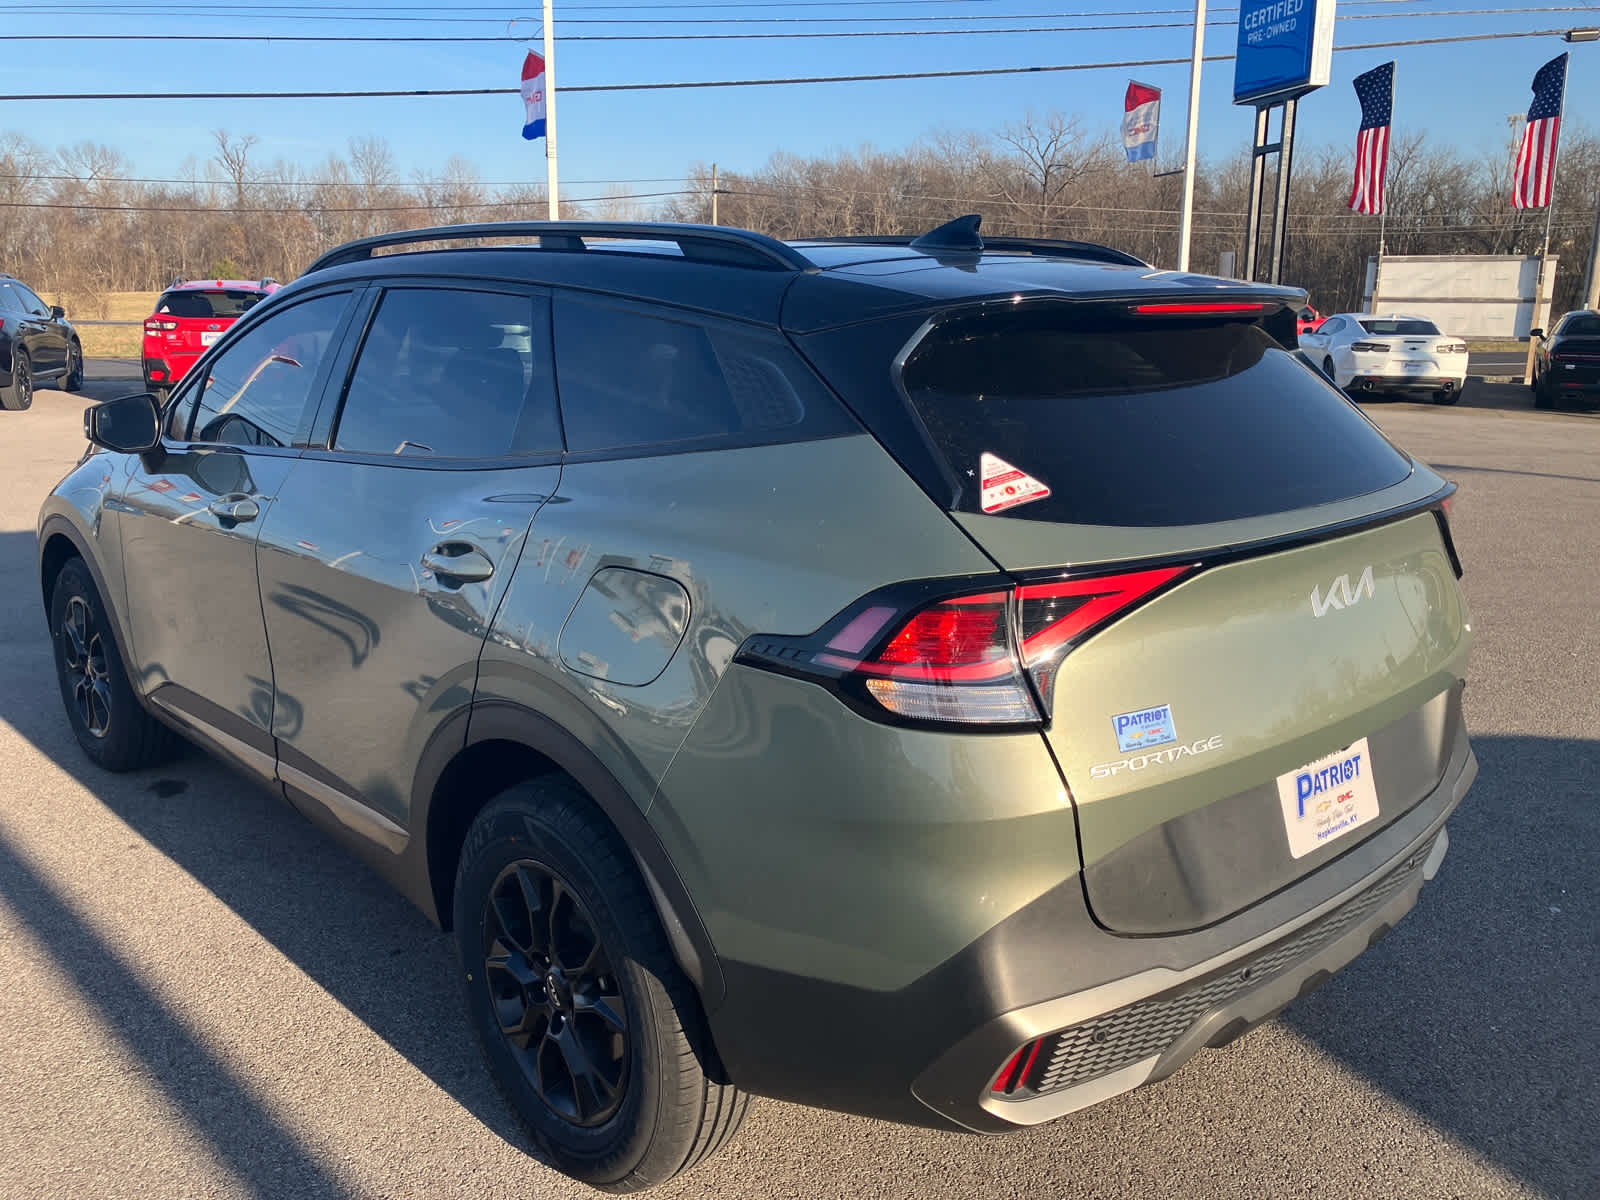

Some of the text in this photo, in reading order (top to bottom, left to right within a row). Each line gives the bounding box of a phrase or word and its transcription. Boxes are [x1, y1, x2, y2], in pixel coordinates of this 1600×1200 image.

[1244, 0, 1304, 30] CERTIFIED
[1247, 17, 1297, 45] PRE-OWNED
[1310, 566, 1376, 618] KIA
[1117, 707, 1169, 736] PATRIOT
[1088, 734, 1224, 780] SPORTAGE
[1296, 754, 1361, 818] PATRIOT
[1337, 790, 1354, 804] GMC
